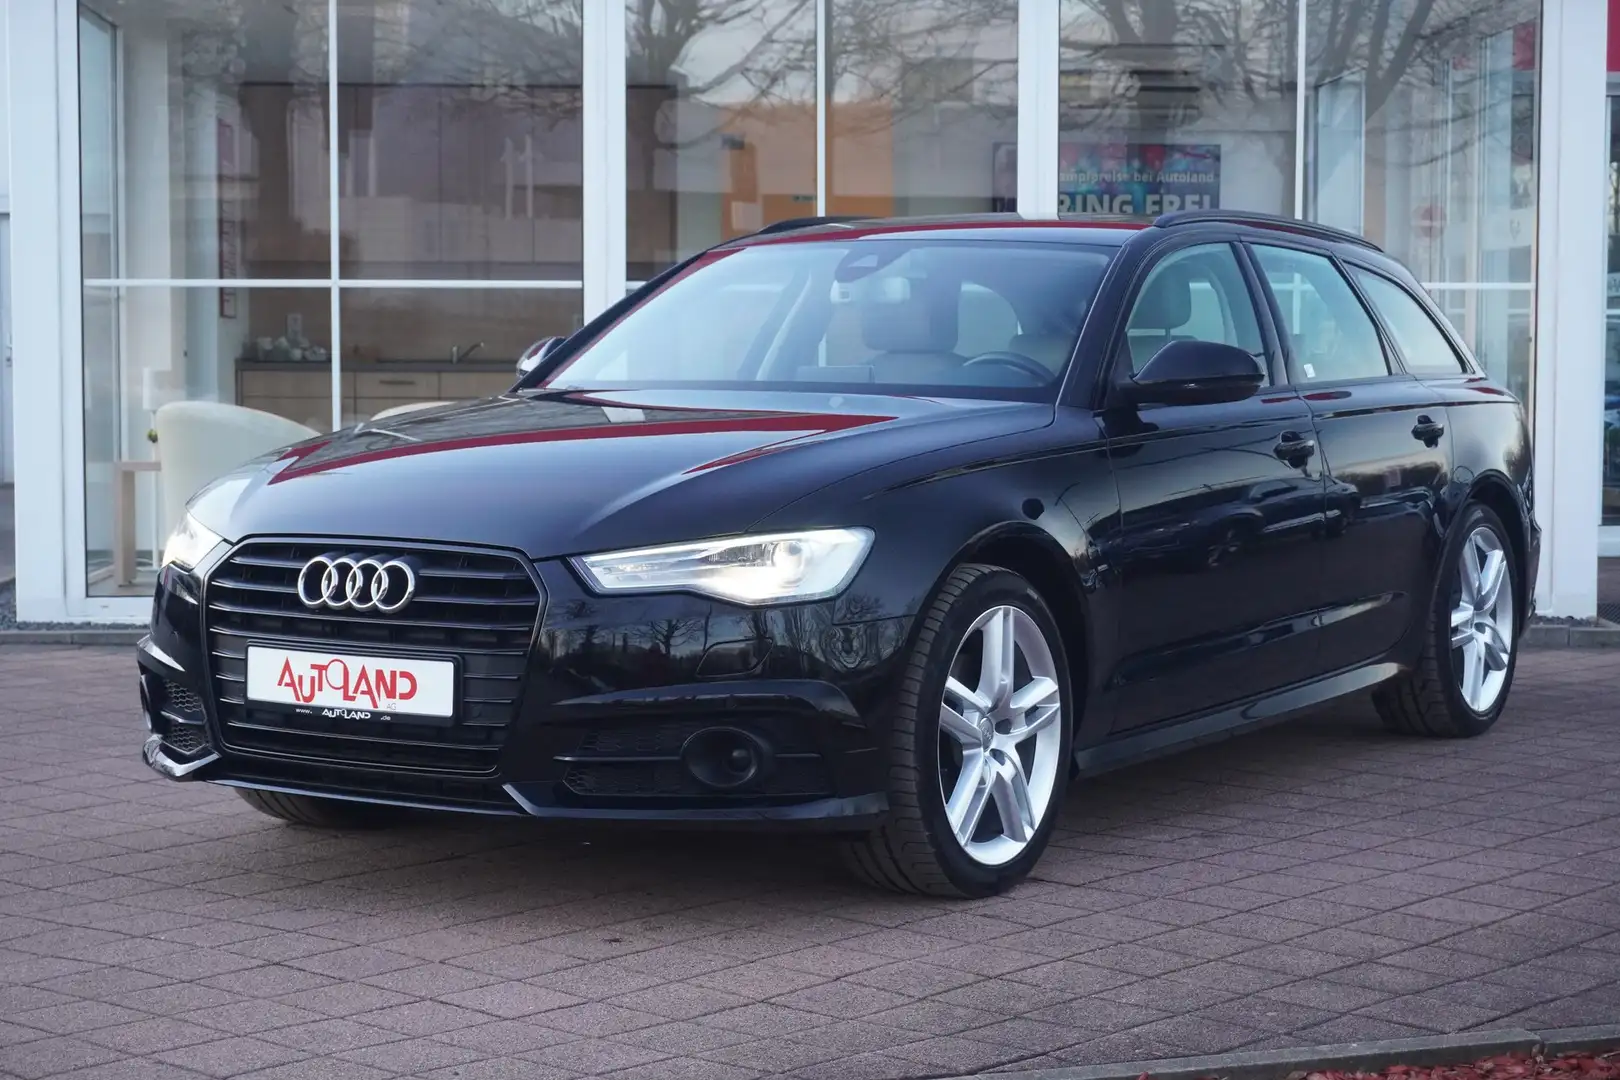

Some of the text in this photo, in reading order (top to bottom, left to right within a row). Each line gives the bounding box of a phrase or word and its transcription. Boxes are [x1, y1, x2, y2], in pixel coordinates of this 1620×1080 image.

[1059, 170, 1214, 184] ampfpreise bei Autoland
[1059, 194, 1211, 214] RING FREI
[277, 656, 417, 709] AUTOLAND
[322, 708, 371, 720] AUTOLAND
[386, 703, 397, 711] AG
